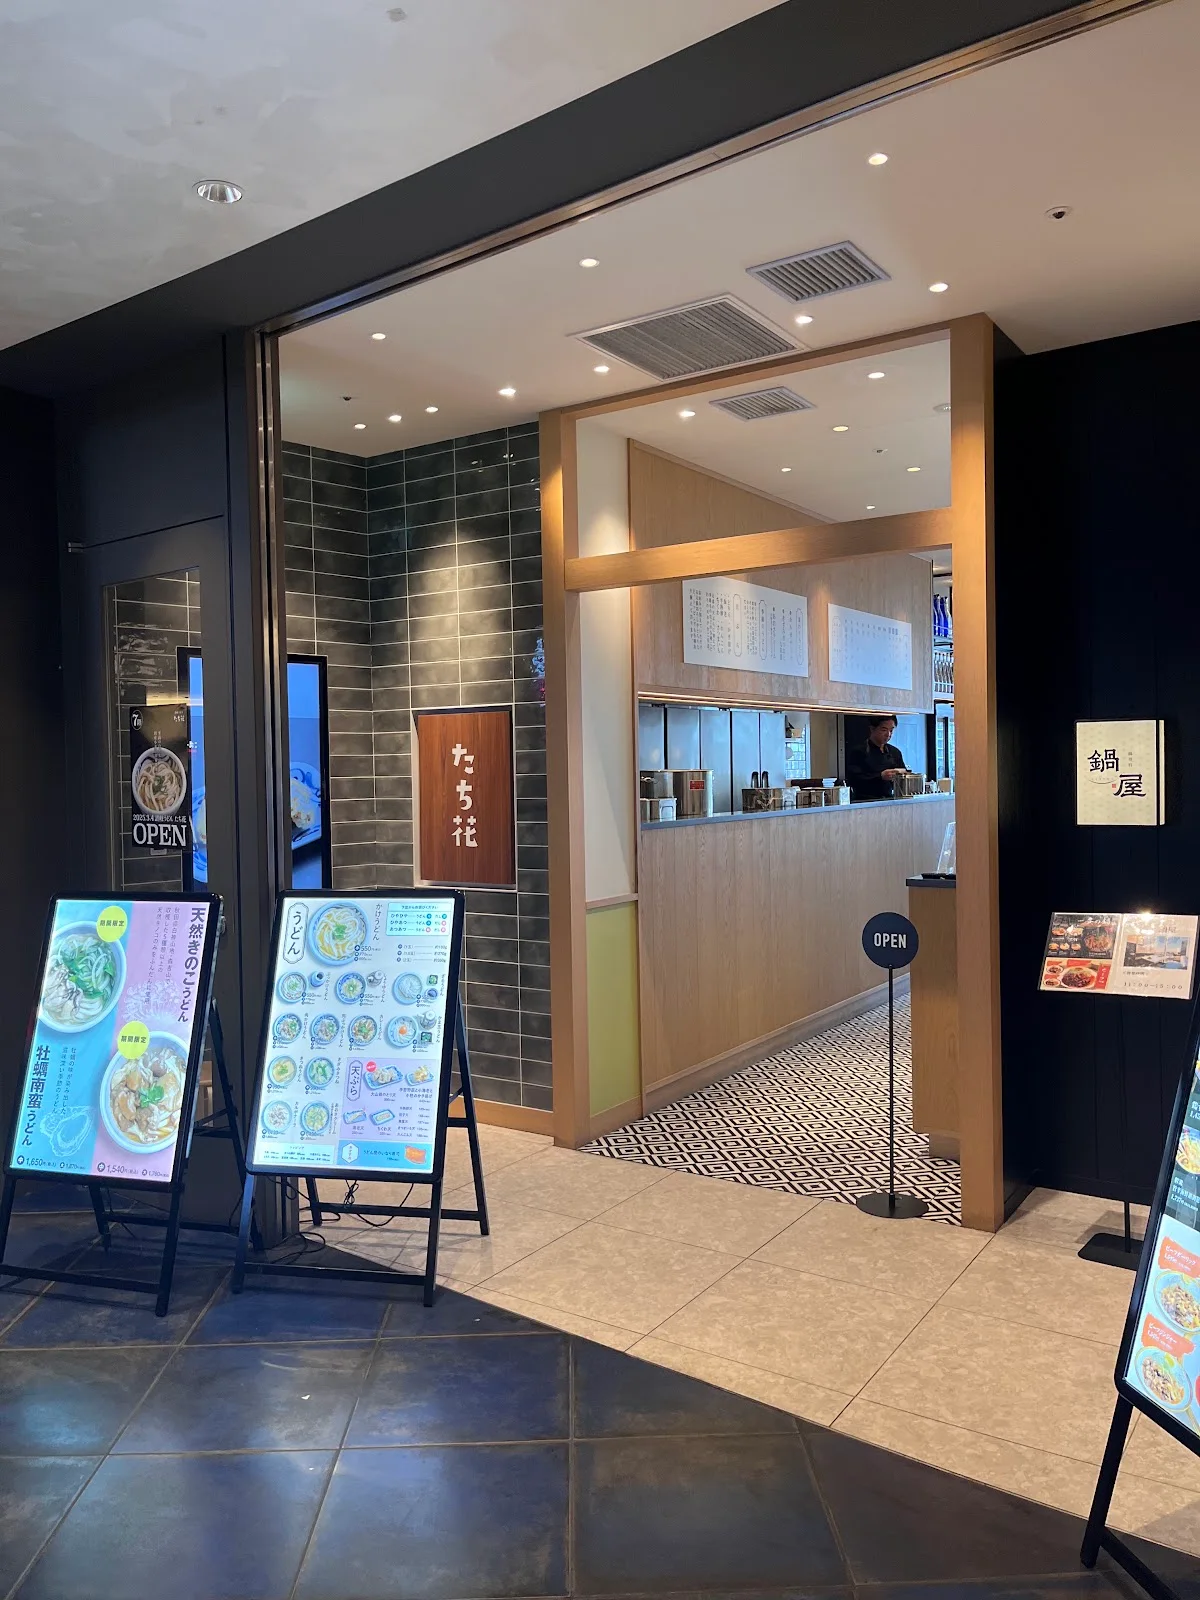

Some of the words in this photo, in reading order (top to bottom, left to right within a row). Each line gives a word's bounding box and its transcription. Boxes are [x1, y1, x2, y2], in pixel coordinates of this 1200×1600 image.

[451, 743, 478, 848] たち花
[132, 822, 187, 847] OPEN
[99, 919, 125, 927] 期間限定
[287, 911, 304, 956] うどん
[372, 903, 383, 941] かけうどん
[873, 932, 907, 949] OPEN
[177, 907, 207, 1023] 天然きのこうどん
[120, 1035, 147, 1044] 期間限定
[21, 1044, 51, 1146] 牡蠣南蛮うどん
[349, 1065, 361, 1096] 天ぷら
